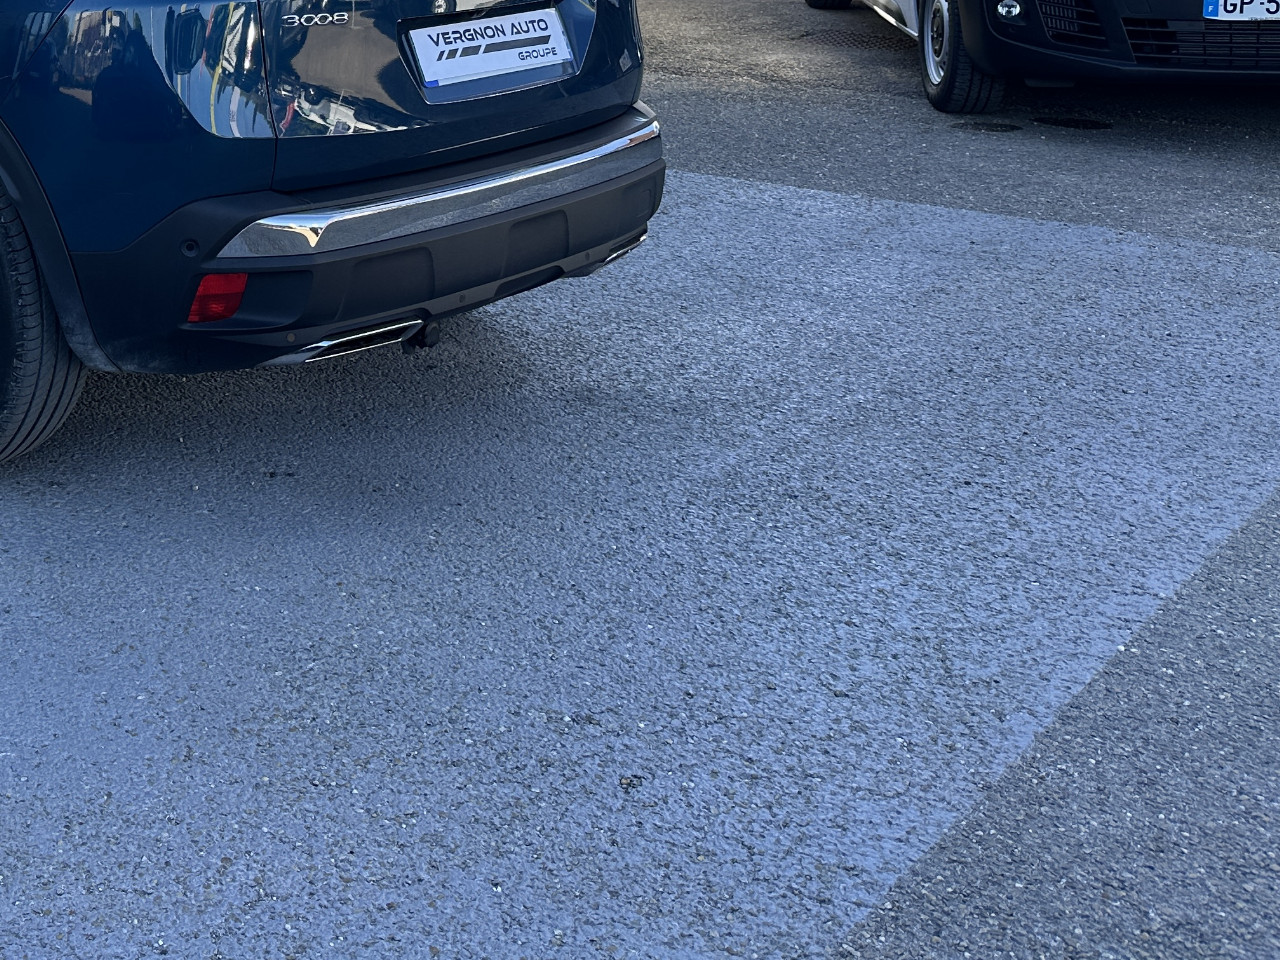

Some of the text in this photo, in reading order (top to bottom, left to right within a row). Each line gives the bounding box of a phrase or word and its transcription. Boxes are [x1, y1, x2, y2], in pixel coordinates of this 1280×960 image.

[281, 12, 349, 27] 3008
[427, 18, 550, 48] VERGNON AUTO
[518, 46, 558, 61] GROUPE
